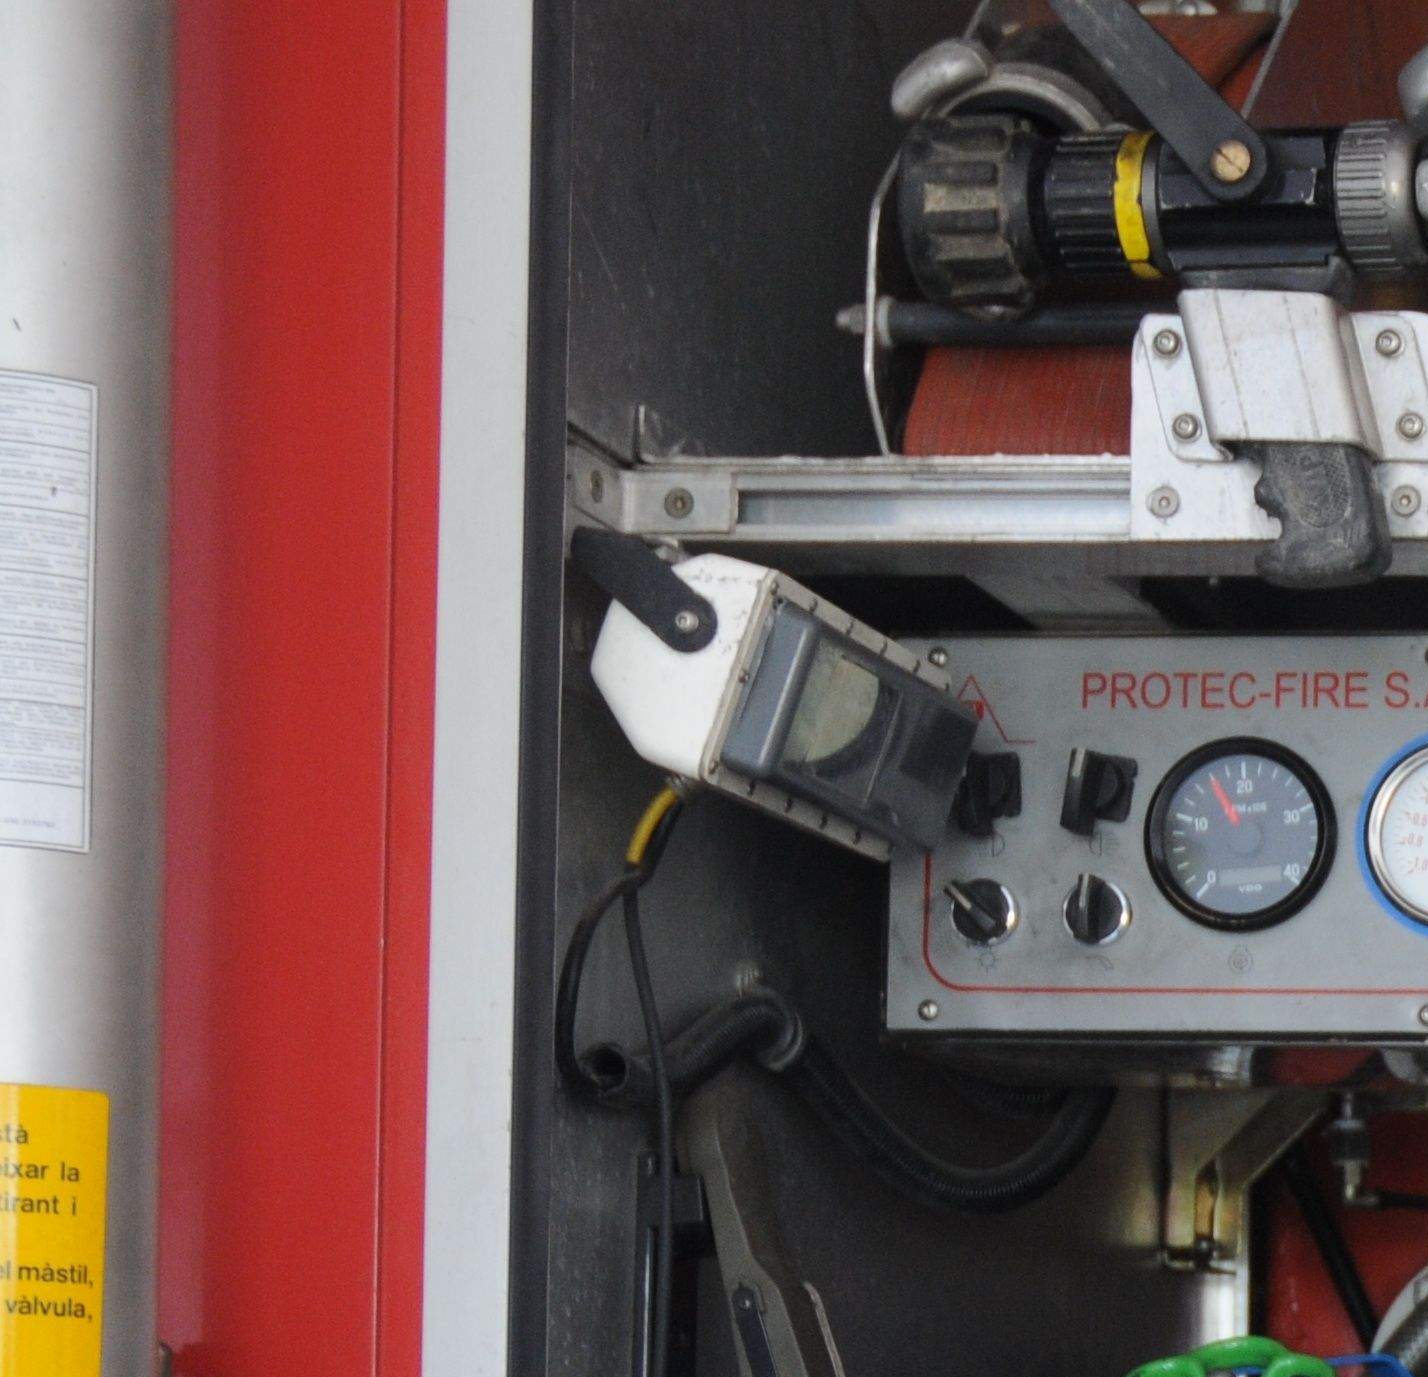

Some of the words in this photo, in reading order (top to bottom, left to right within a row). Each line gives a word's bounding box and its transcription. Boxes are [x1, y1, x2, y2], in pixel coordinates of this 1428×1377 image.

[1080, 670, 1369, 711] PROTEC-FIRE
[1236, 779, 1253, 794] 20
[1194, 817, 1208, 831] 10
[1283, 809, 1300, 824] 30
[1206, 870, 1217, 884] 0
[1283, 864, 1300, 876] 40
[1238, 883, 1263, 893] VDO
[0, 1156, 49, 1180] ixar
[60, 1161, 80, 1182] la
[71, 1196, 78, 1217] i
